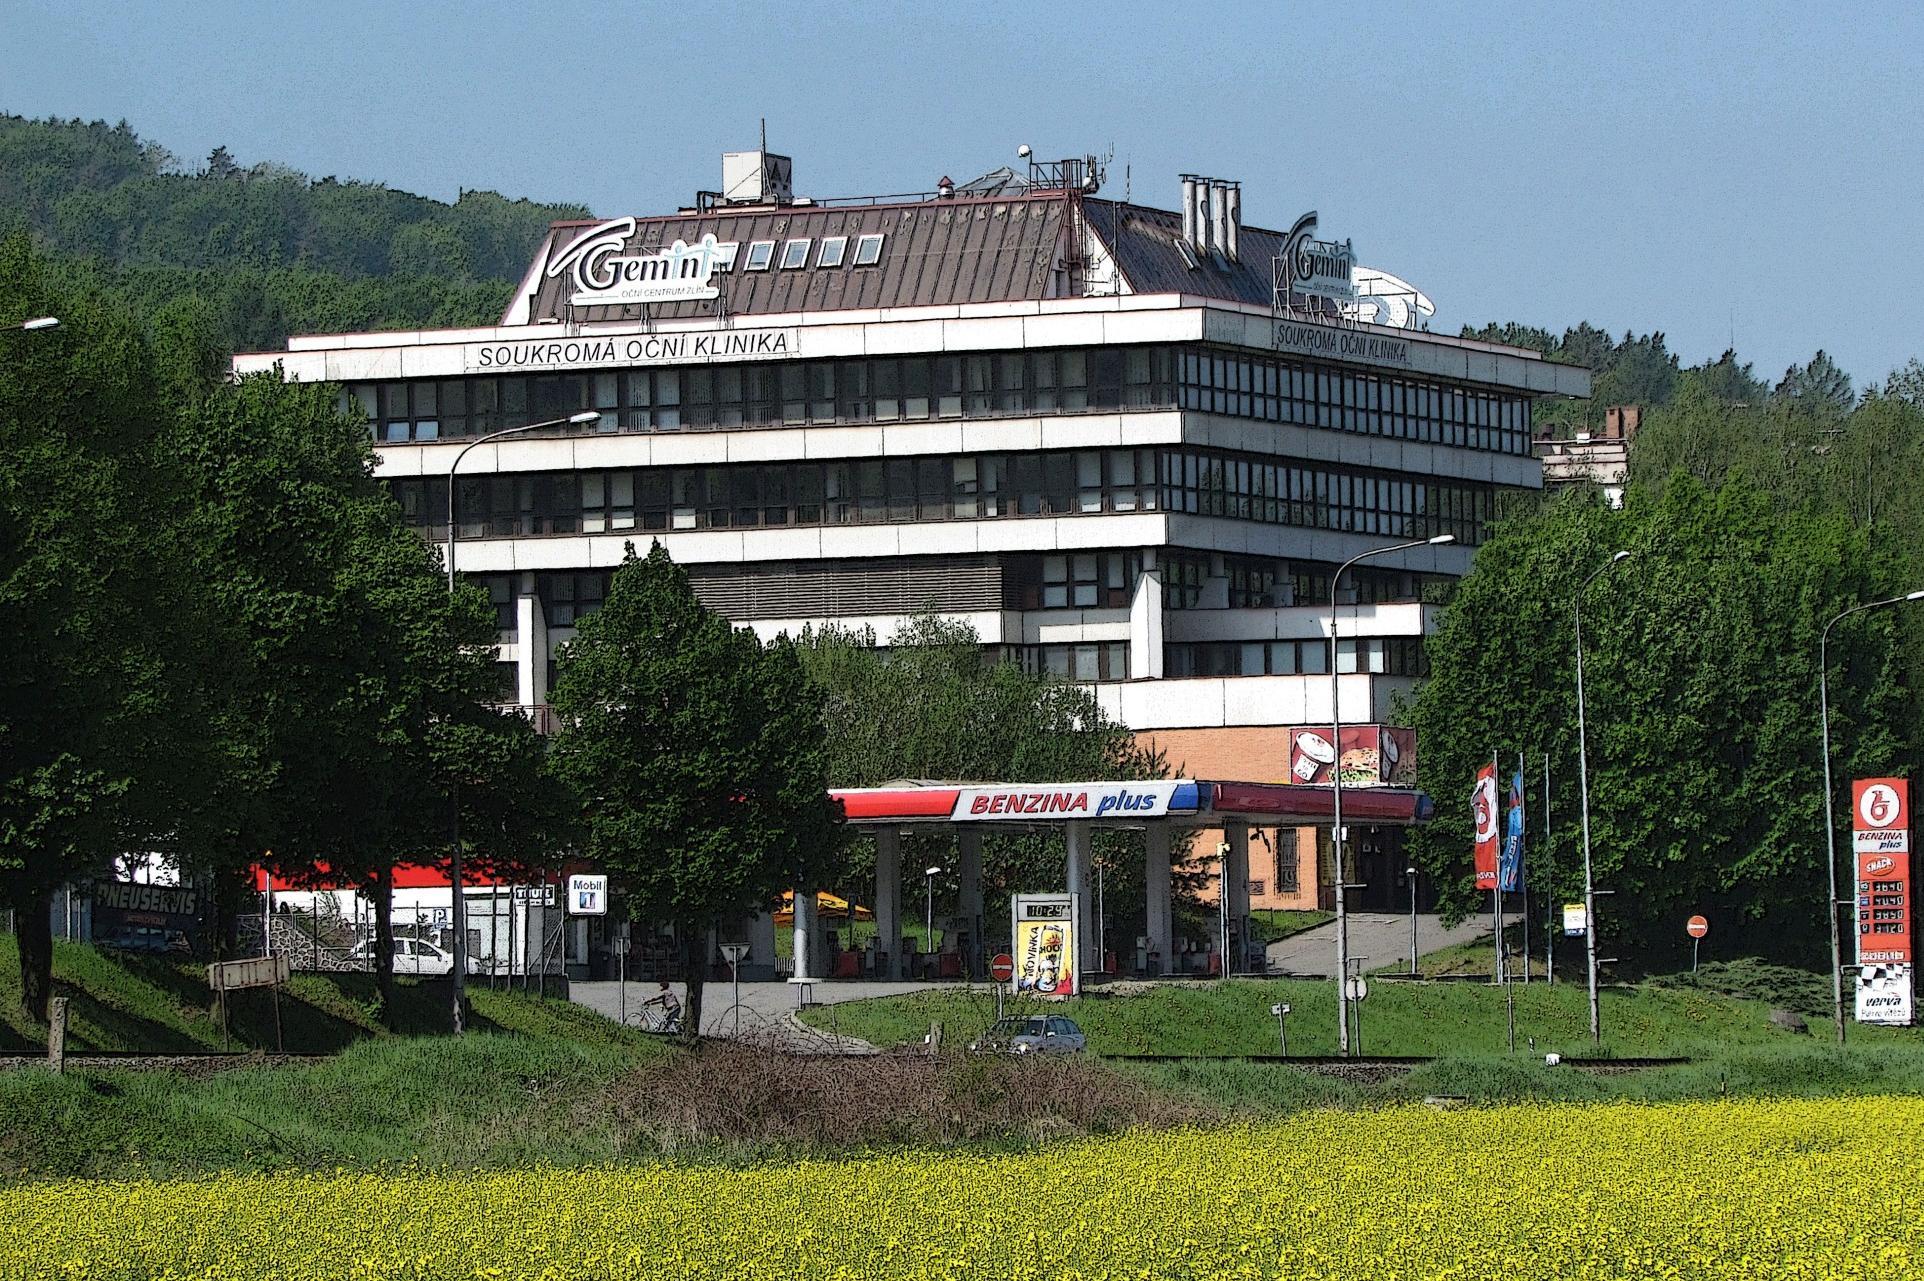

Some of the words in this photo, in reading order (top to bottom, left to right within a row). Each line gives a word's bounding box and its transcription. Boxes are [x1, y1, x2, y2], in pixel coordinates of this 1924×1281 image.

[579, 239, 719, 290] Gemini
[1295, 234, 1351, 281] Gemini
[644, 288, 685, 297] CENTRUM
[685, 286, 705, 295] ZLÍN
[479, 337, 616, 367] SOUKROMÁ
[626, 338, 686, 360] OČNÍ
[694, 333, 788, 356] KLINIKA
[1278, 324, 1337, 352] SOUKROMÁ
[1340, 333, 1367, 356] OČNÍ
[1368, 339, 1407, 360] KLINIKA
[970, 792, 1088, 814] BENZINA
[1096, 790, 1157, 816] plus
[1858, 832, 1903, 840] BENZINA
[1879, 840, 1902, 850] plus
[573, 879, 602, 890] Mobil
[97, 884, 197, 915] PNEUSERVIS
[435, 910, 445, 923] P
[1026, 926, 1039, 977] NOVINKA
[1866, 997, 1902, 1006] verva
